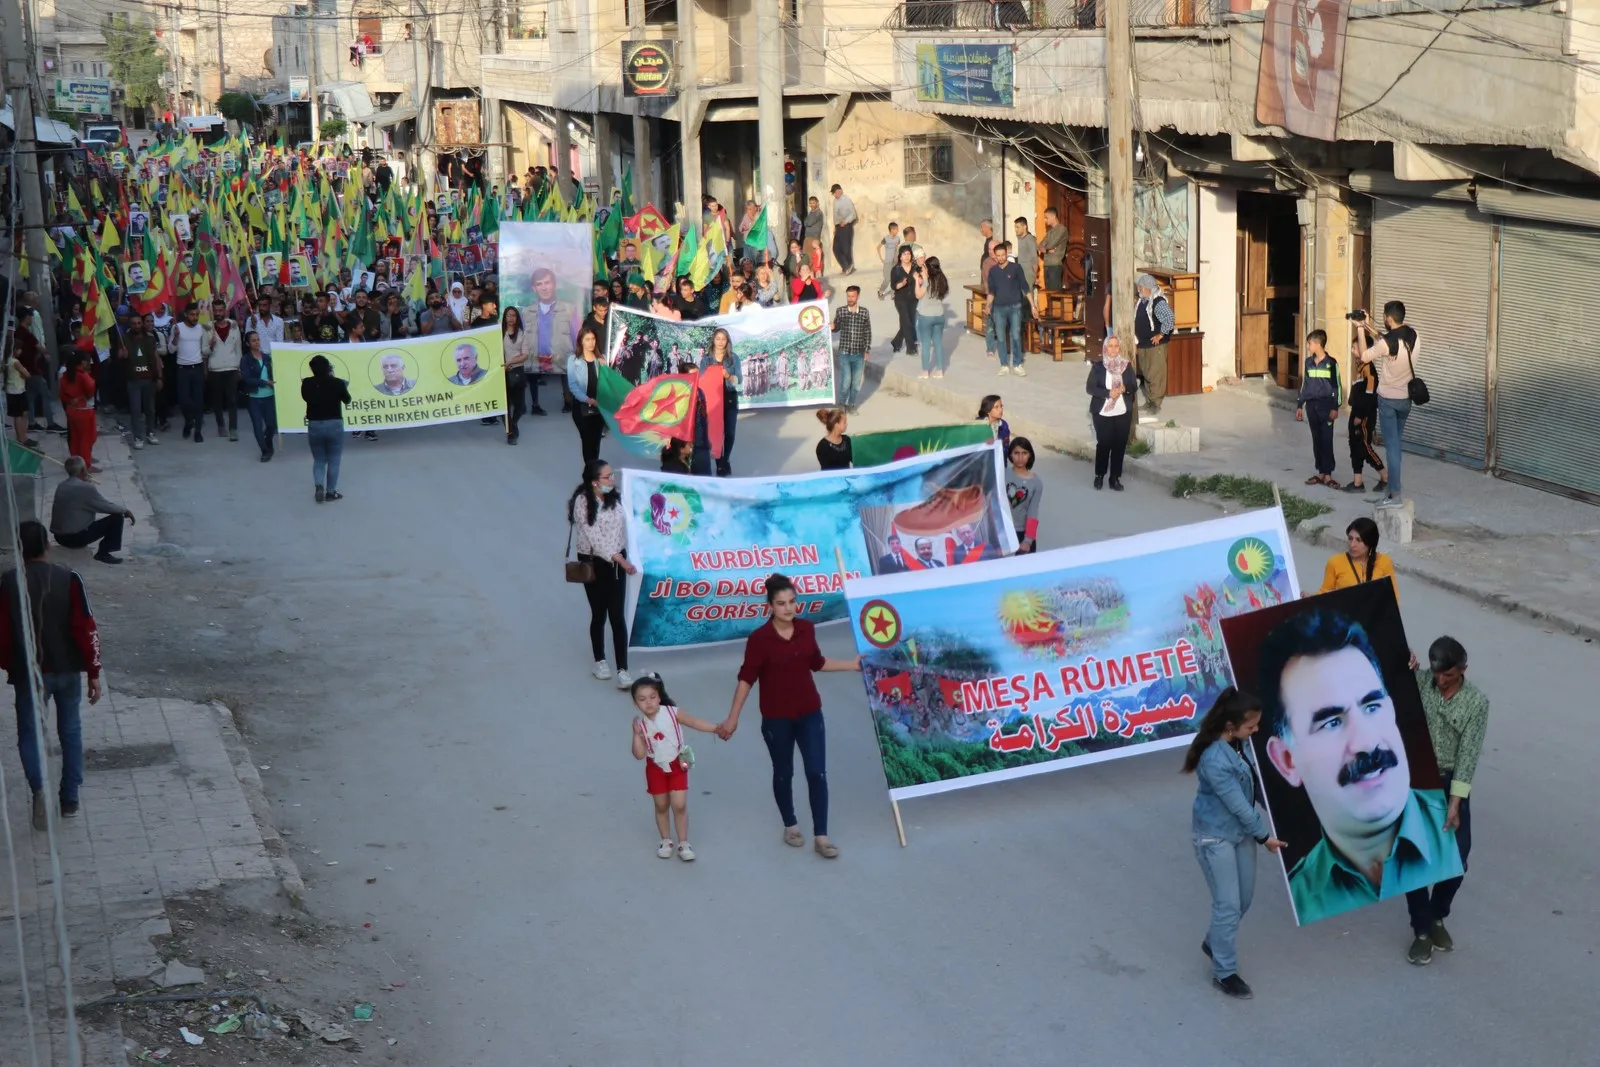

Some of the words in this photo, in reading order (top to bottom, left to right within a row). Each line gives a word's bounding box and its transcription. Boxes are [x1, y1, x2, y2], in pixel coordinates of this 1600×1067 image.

[347, 415, 359, 426] LI
[360, 414, 382, 425] SER
[385, 409, 431, 423] NIRXÊN
[432, 403, 461, 419] GELÊ
[464, 401, 482, 414] ME
[484, 399, 499, 411] YE
[388, 399, 399, 409] LI
[403, 397, 423, 408] SER
[425, 391, 454, 405] WAN
[690, 544, 819, 571] KURDİSTAN
[676, 580, 711, 598] BO
[961, 671, 1055, 714] MEŞA
[1059, 638, 1198, 697] RÛMETÊ
[987, 702, 1098, 753] الكرامة
[1101, 693, 1197, 739] مسيرة
